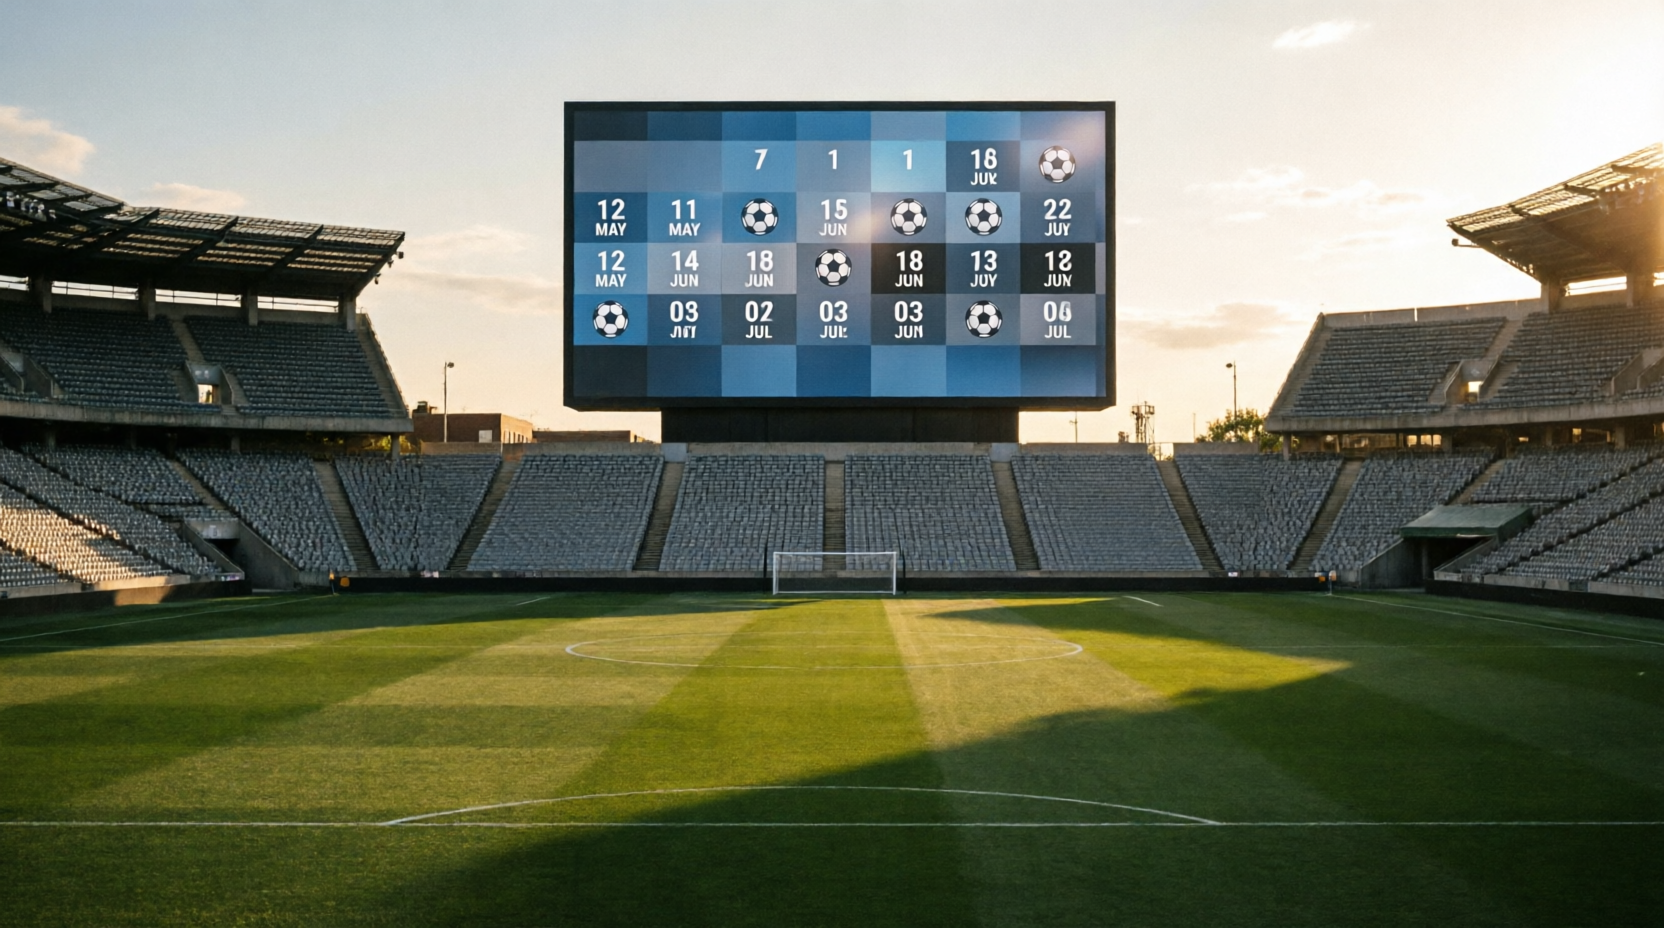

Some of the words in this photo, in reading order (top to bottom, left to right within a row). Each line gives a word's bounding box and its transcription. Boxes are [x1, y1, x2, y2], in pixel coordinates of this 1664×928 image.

[755, 149, 768, 170] 7
[828, 149, 838, 170] 1
[903, 149, 913, 170] 1
[597, 199, 625, 220] 12
[671, 199, 696, 220] 11
[820, 199, 848, 220] 15
[1043, 198, 1072, 220] 22
[595, 223, 627, 236] MAY
[669, 223, 701, 236] MAY
[819, 223, 847, 236] JUN
[597, 250, 625, 271] 12
[671, 250, 699, 271] 14
[746, 250, 774, 271] 18
[896, 250, 923, 271] 18
[970, 250, 998, 271] 13
[595, 274, 627, 287] MAY
[670, 274, 699, 287] JUN
[745, 274, 774, 287] JUN
[895, 274, 924, 287] JUN
[745, 300, 773, 322] 02
[819, 300, 848, 322] 03
[894, 301, 923, 322] 03
[745, 325, 773, 338] JUL
[894, 325, 924, 338] JUN
[1044, 325, 1072, 338] JUL
